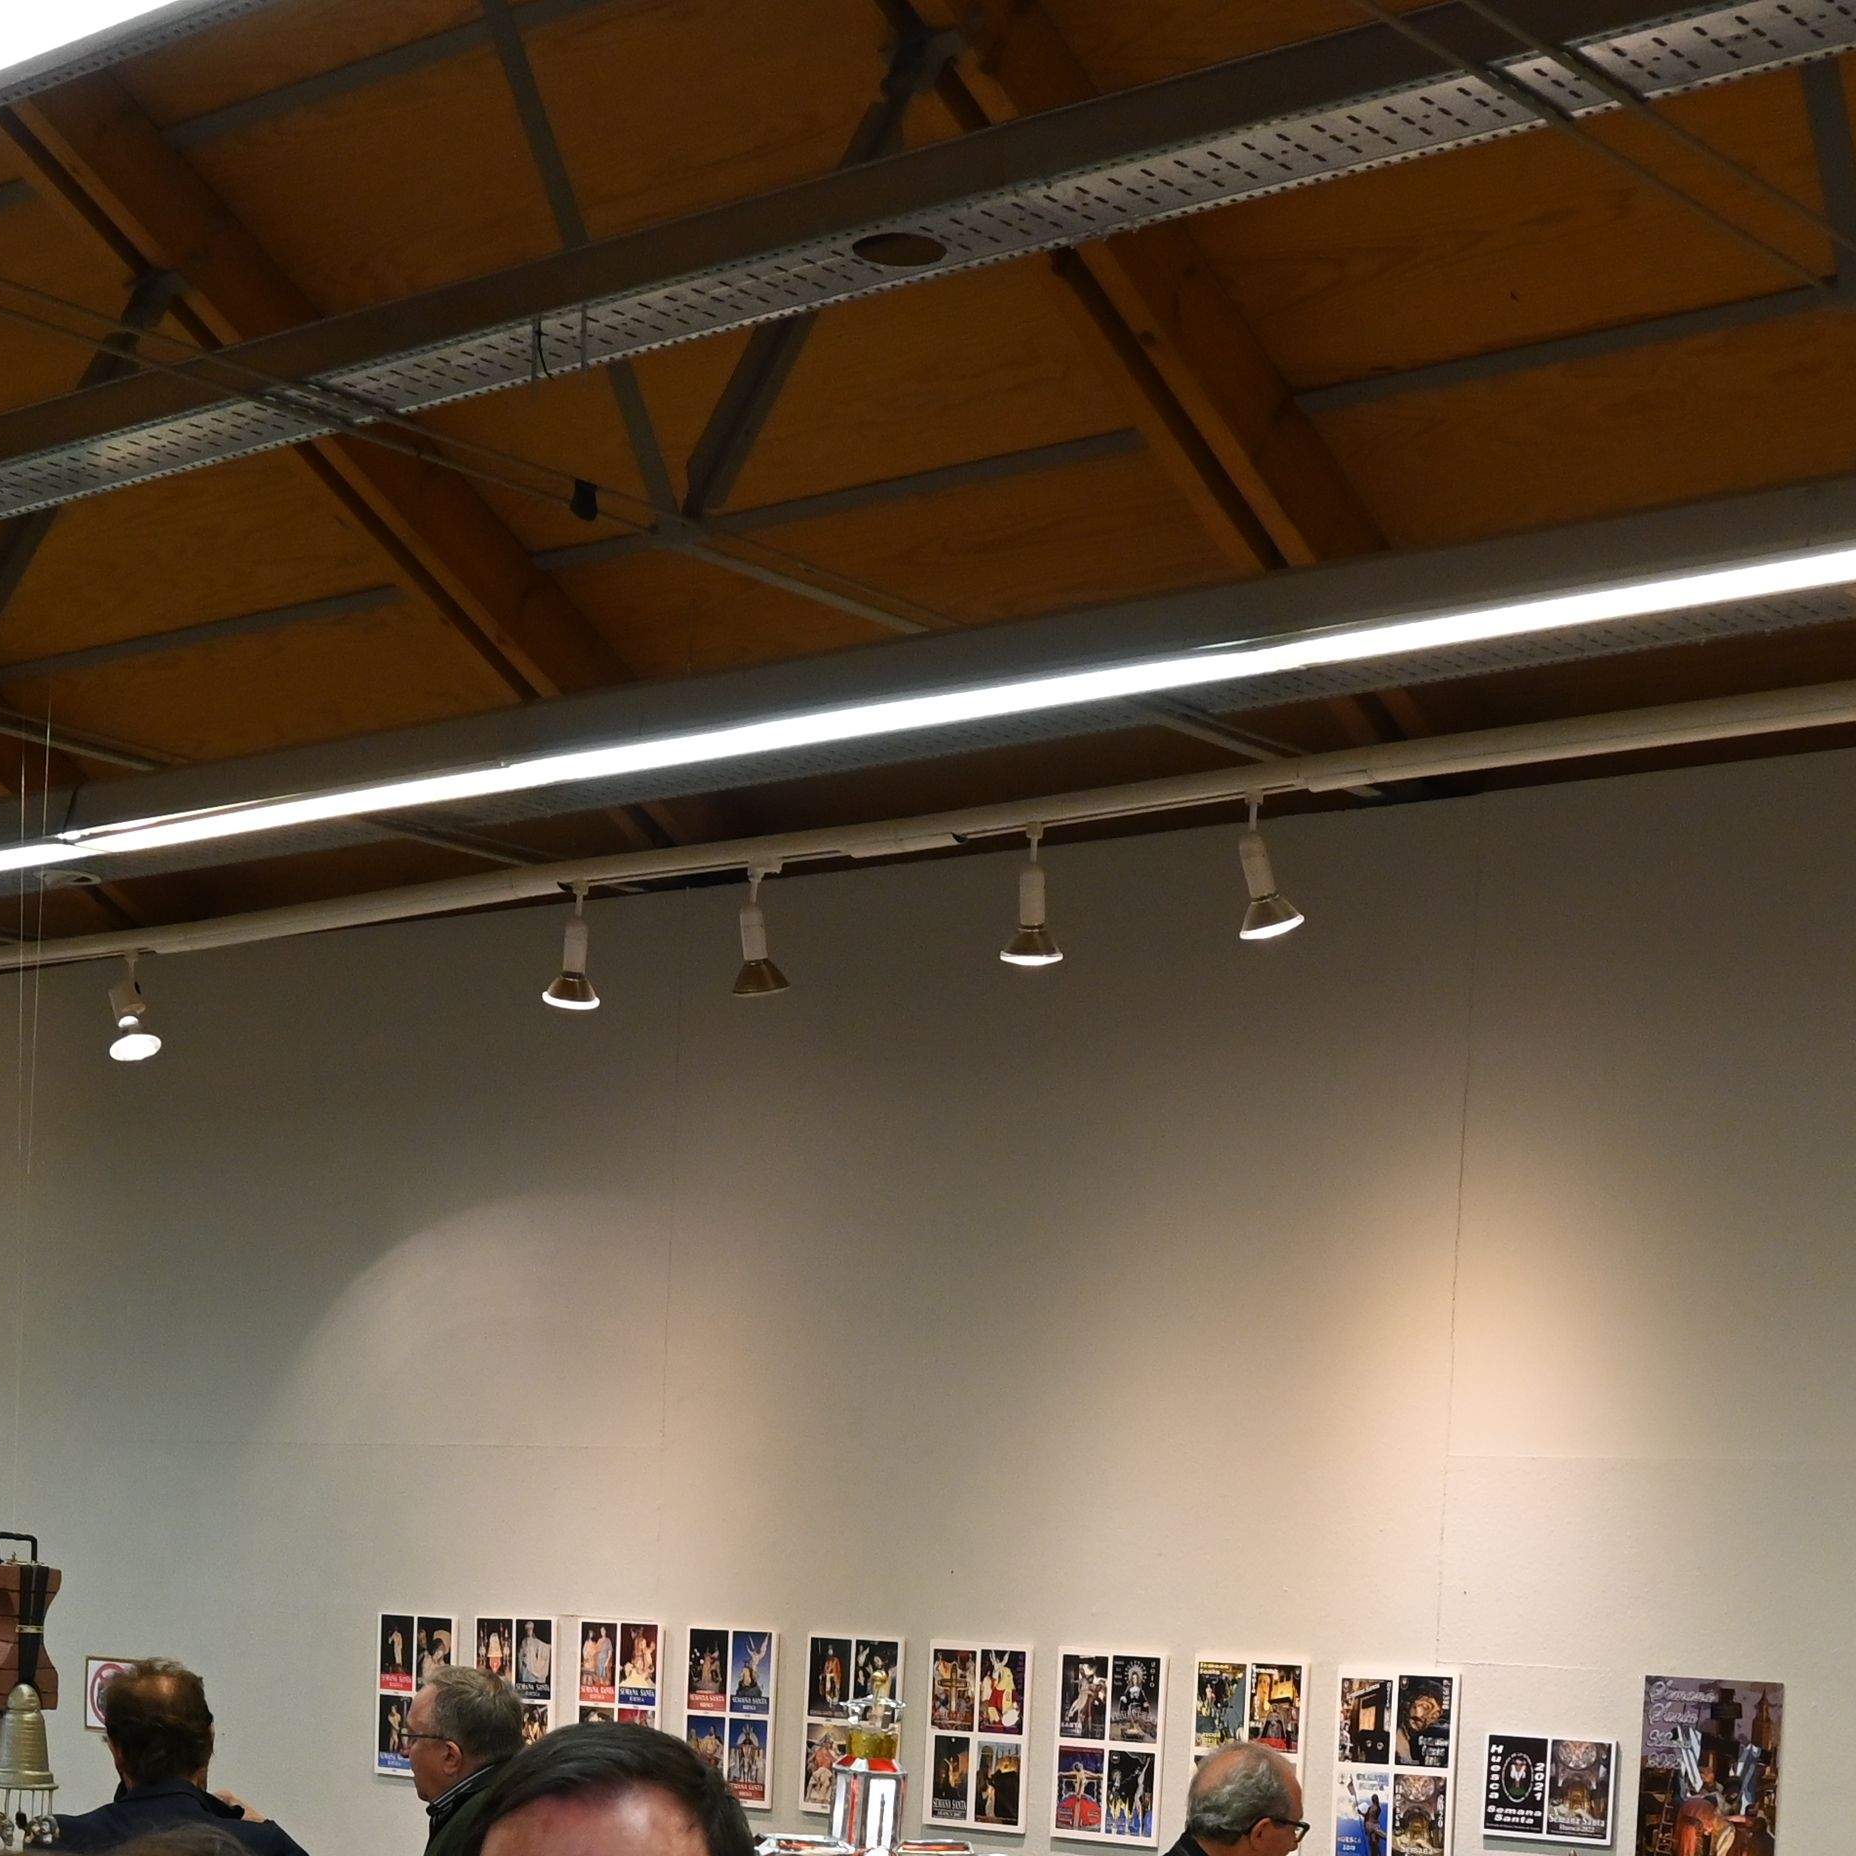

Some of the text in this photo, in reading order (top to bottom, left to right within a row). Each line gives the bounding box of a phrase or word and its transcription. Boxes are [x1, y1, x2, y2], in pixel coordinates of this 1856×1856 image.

[1488, 1744, 1504, 1799] Huesca
[1533, 1762, 1545, 1801] 2021
[1487, 1805, 1543, 1817] Semana
[1494, 1813, 1534, 1824] Santa
